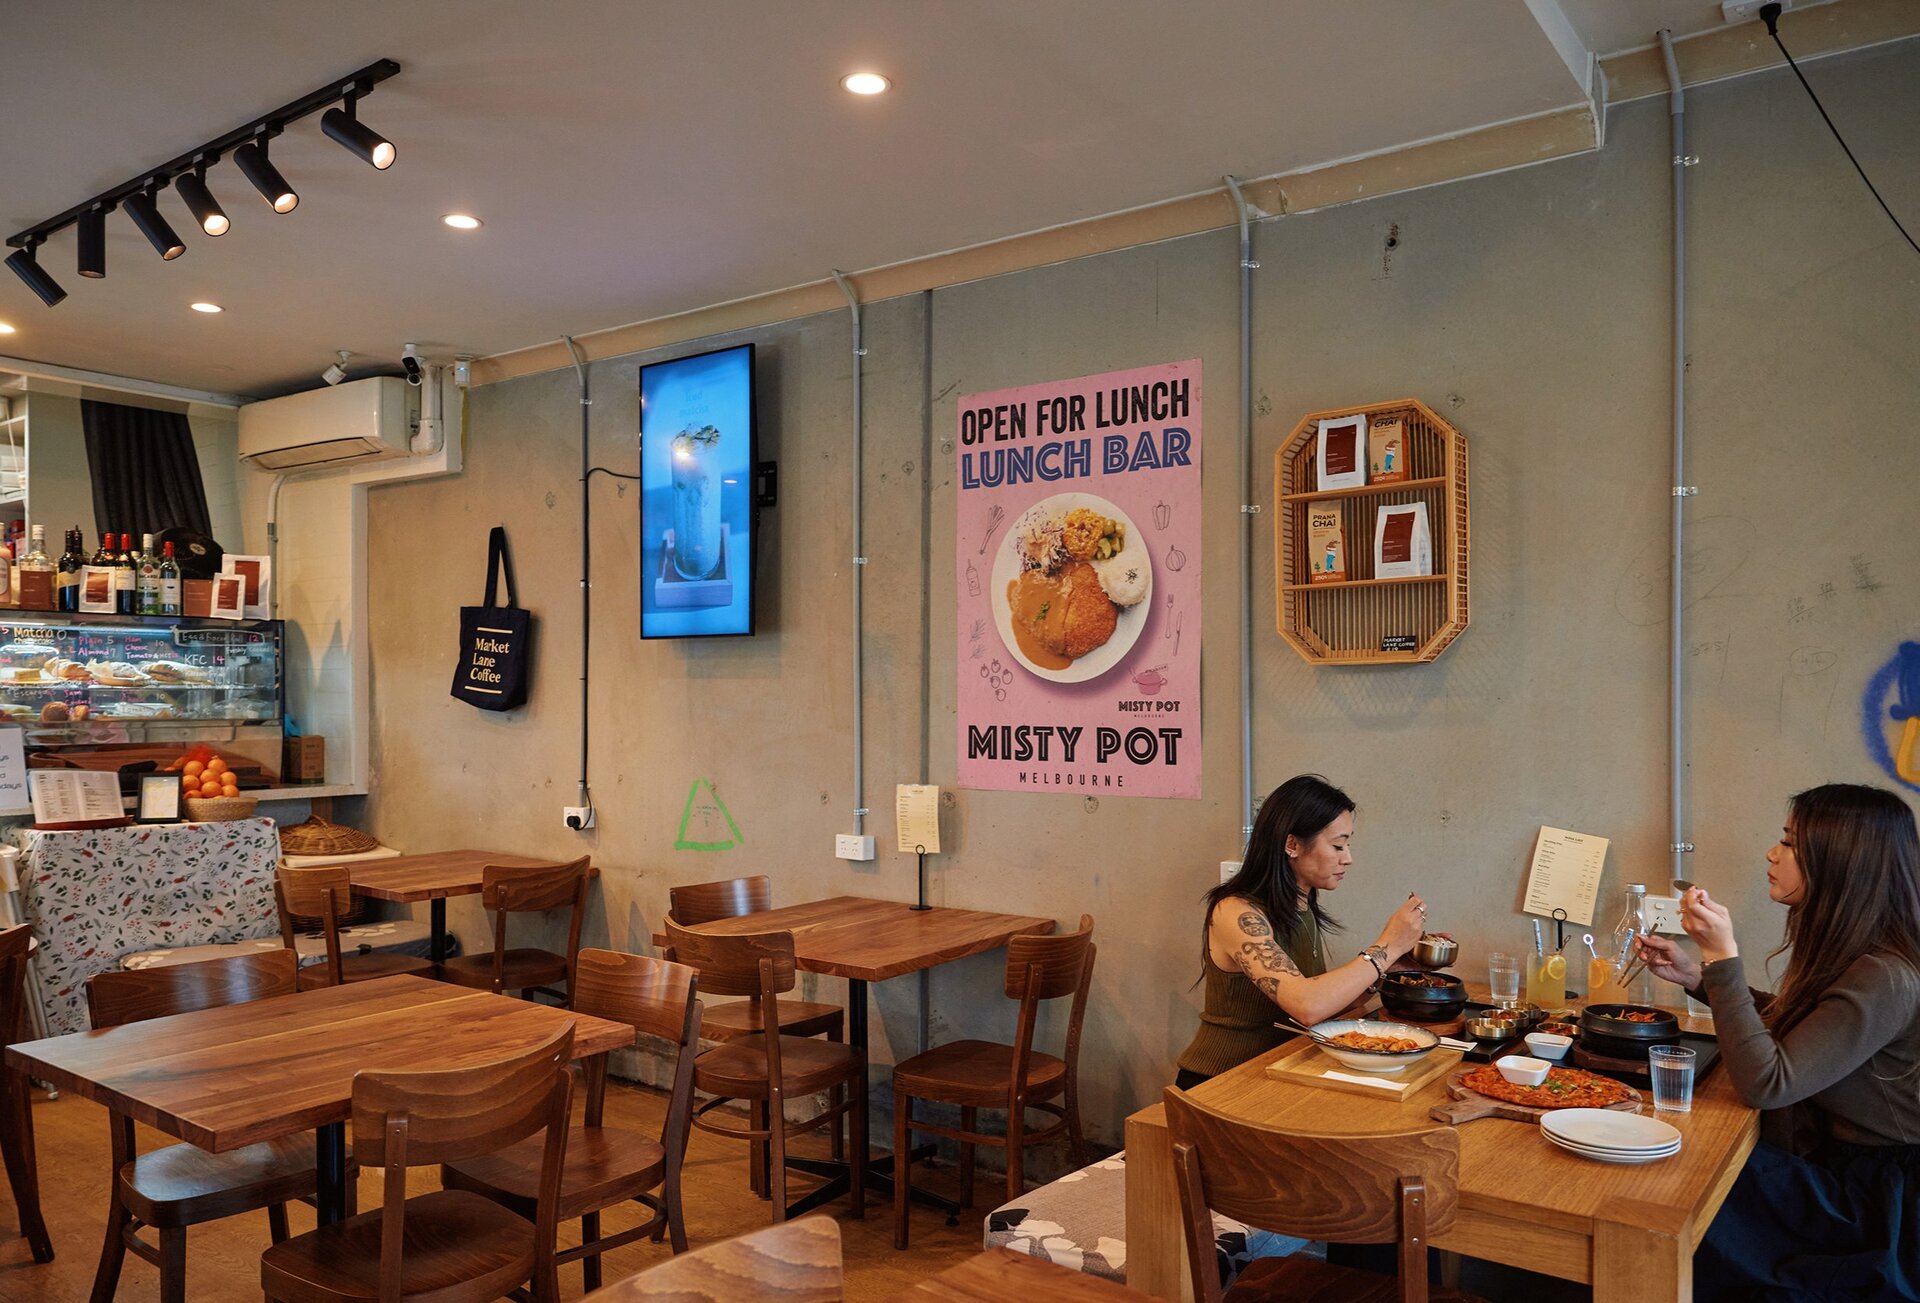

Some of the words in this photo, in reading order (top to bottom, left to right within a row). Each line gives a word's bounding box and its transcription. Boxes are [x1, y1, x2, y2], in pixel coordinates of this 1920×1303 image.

[961, 402, 1026, 446] OPEN
[1036, 394, 1086, 436] FOR
[1095, 378, 1190, 429] LUNCH
[1374, 419, 1398, 428] CHAI
[962, 438, 1091, 490] LUNCH
[1103, 426, 1192, 475] BAR
[1312, 520, 1336, 528] CHAI
[14, 627, 54, 639] Matcha
[249, 634, 259, 642] 12
[79, 636, 103, 645] Plain
[107, 636, 114, 645] 5
[475, 638, 510, 653] Market
[78, 647, 110, 656] Almond
[184, 654, 207, 665] KFC
[212, 655, 225, 664] 14
[473, 653, 495, 667] Lane
[470, 667, 502, 683] Coffee
[1118, 701, 1153, 712] MISTY
[1155, 700, 1181, 713] POT
[967, 724, 1084, 763] MISTY
[1096, 725, 1183, 766] POT
[1019, 771, 1124, 788] MELBOURNE
